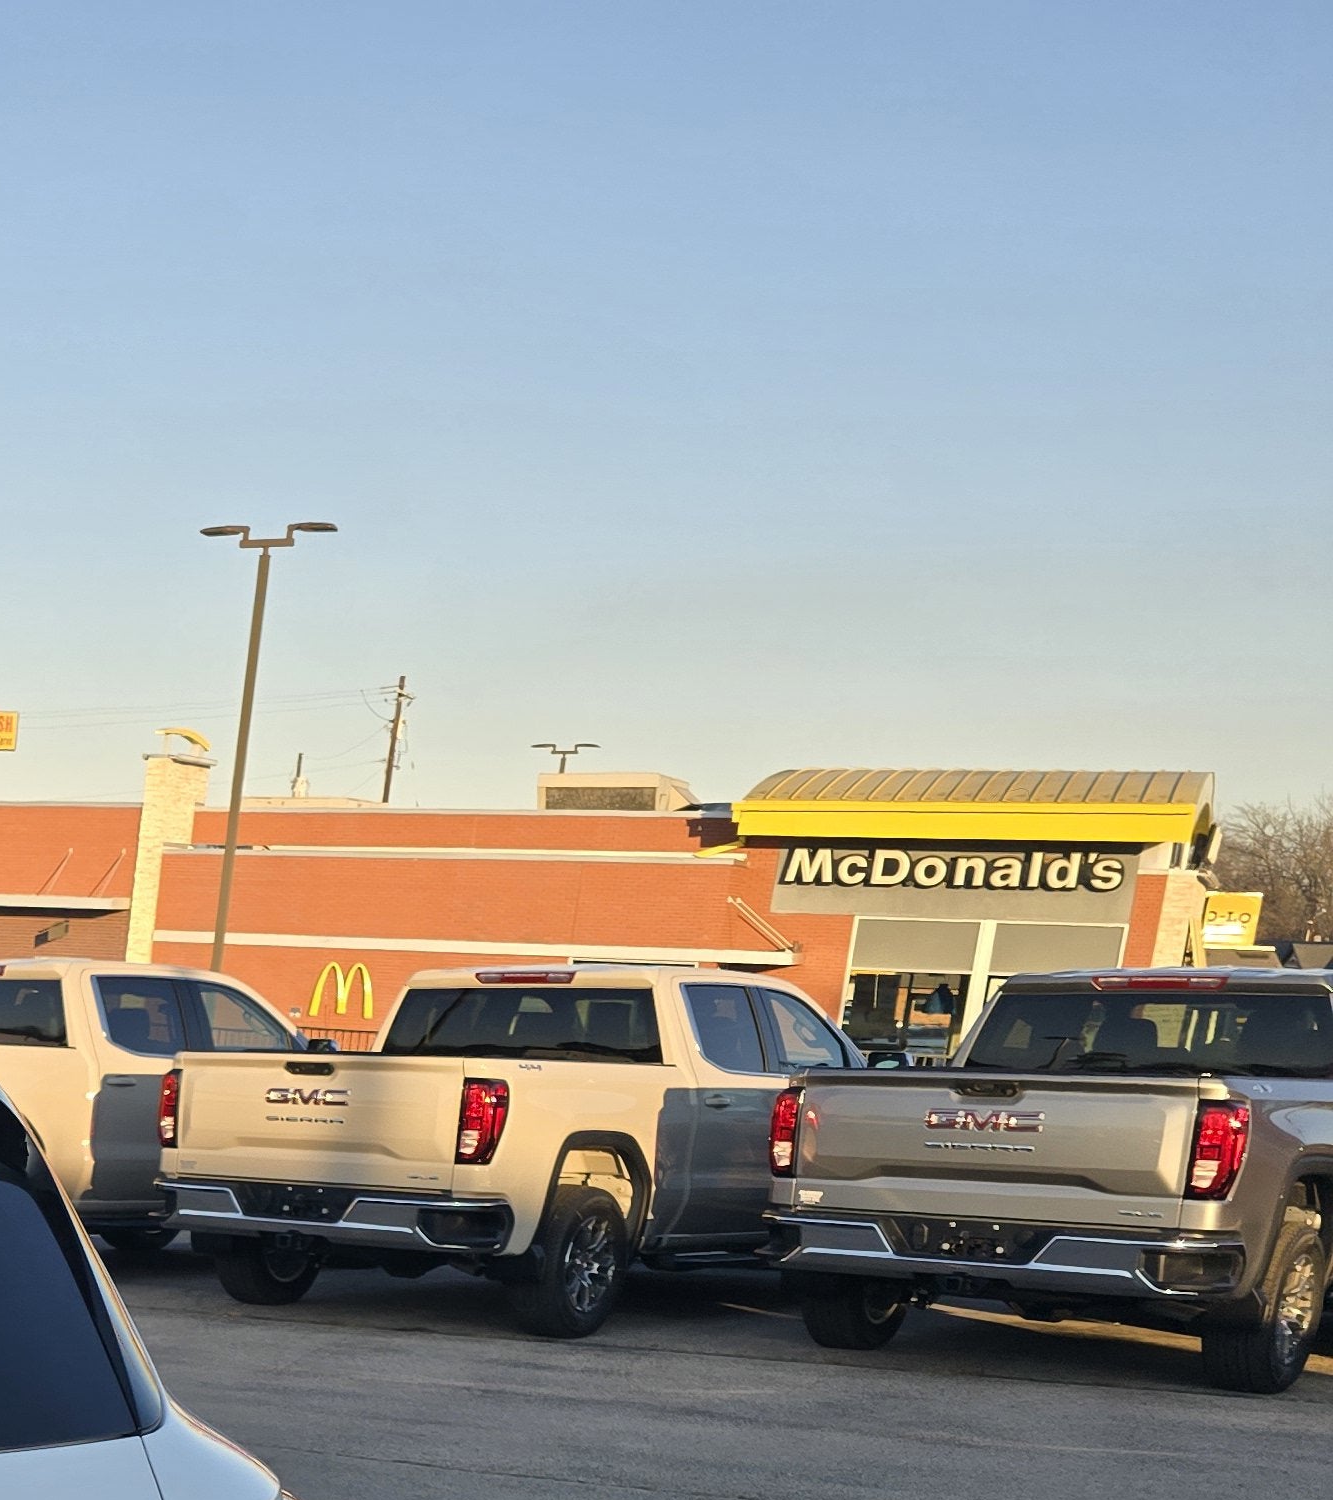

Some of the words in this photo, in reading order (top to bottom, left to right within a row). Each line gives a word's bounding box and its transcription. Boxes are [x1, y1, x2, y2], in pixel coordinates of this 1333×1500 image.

[779, 846, 1125, 892] McDonald's
[265, 1088, 351, 1106] GMC
[924, 1107, 1046, 1133] GMC
